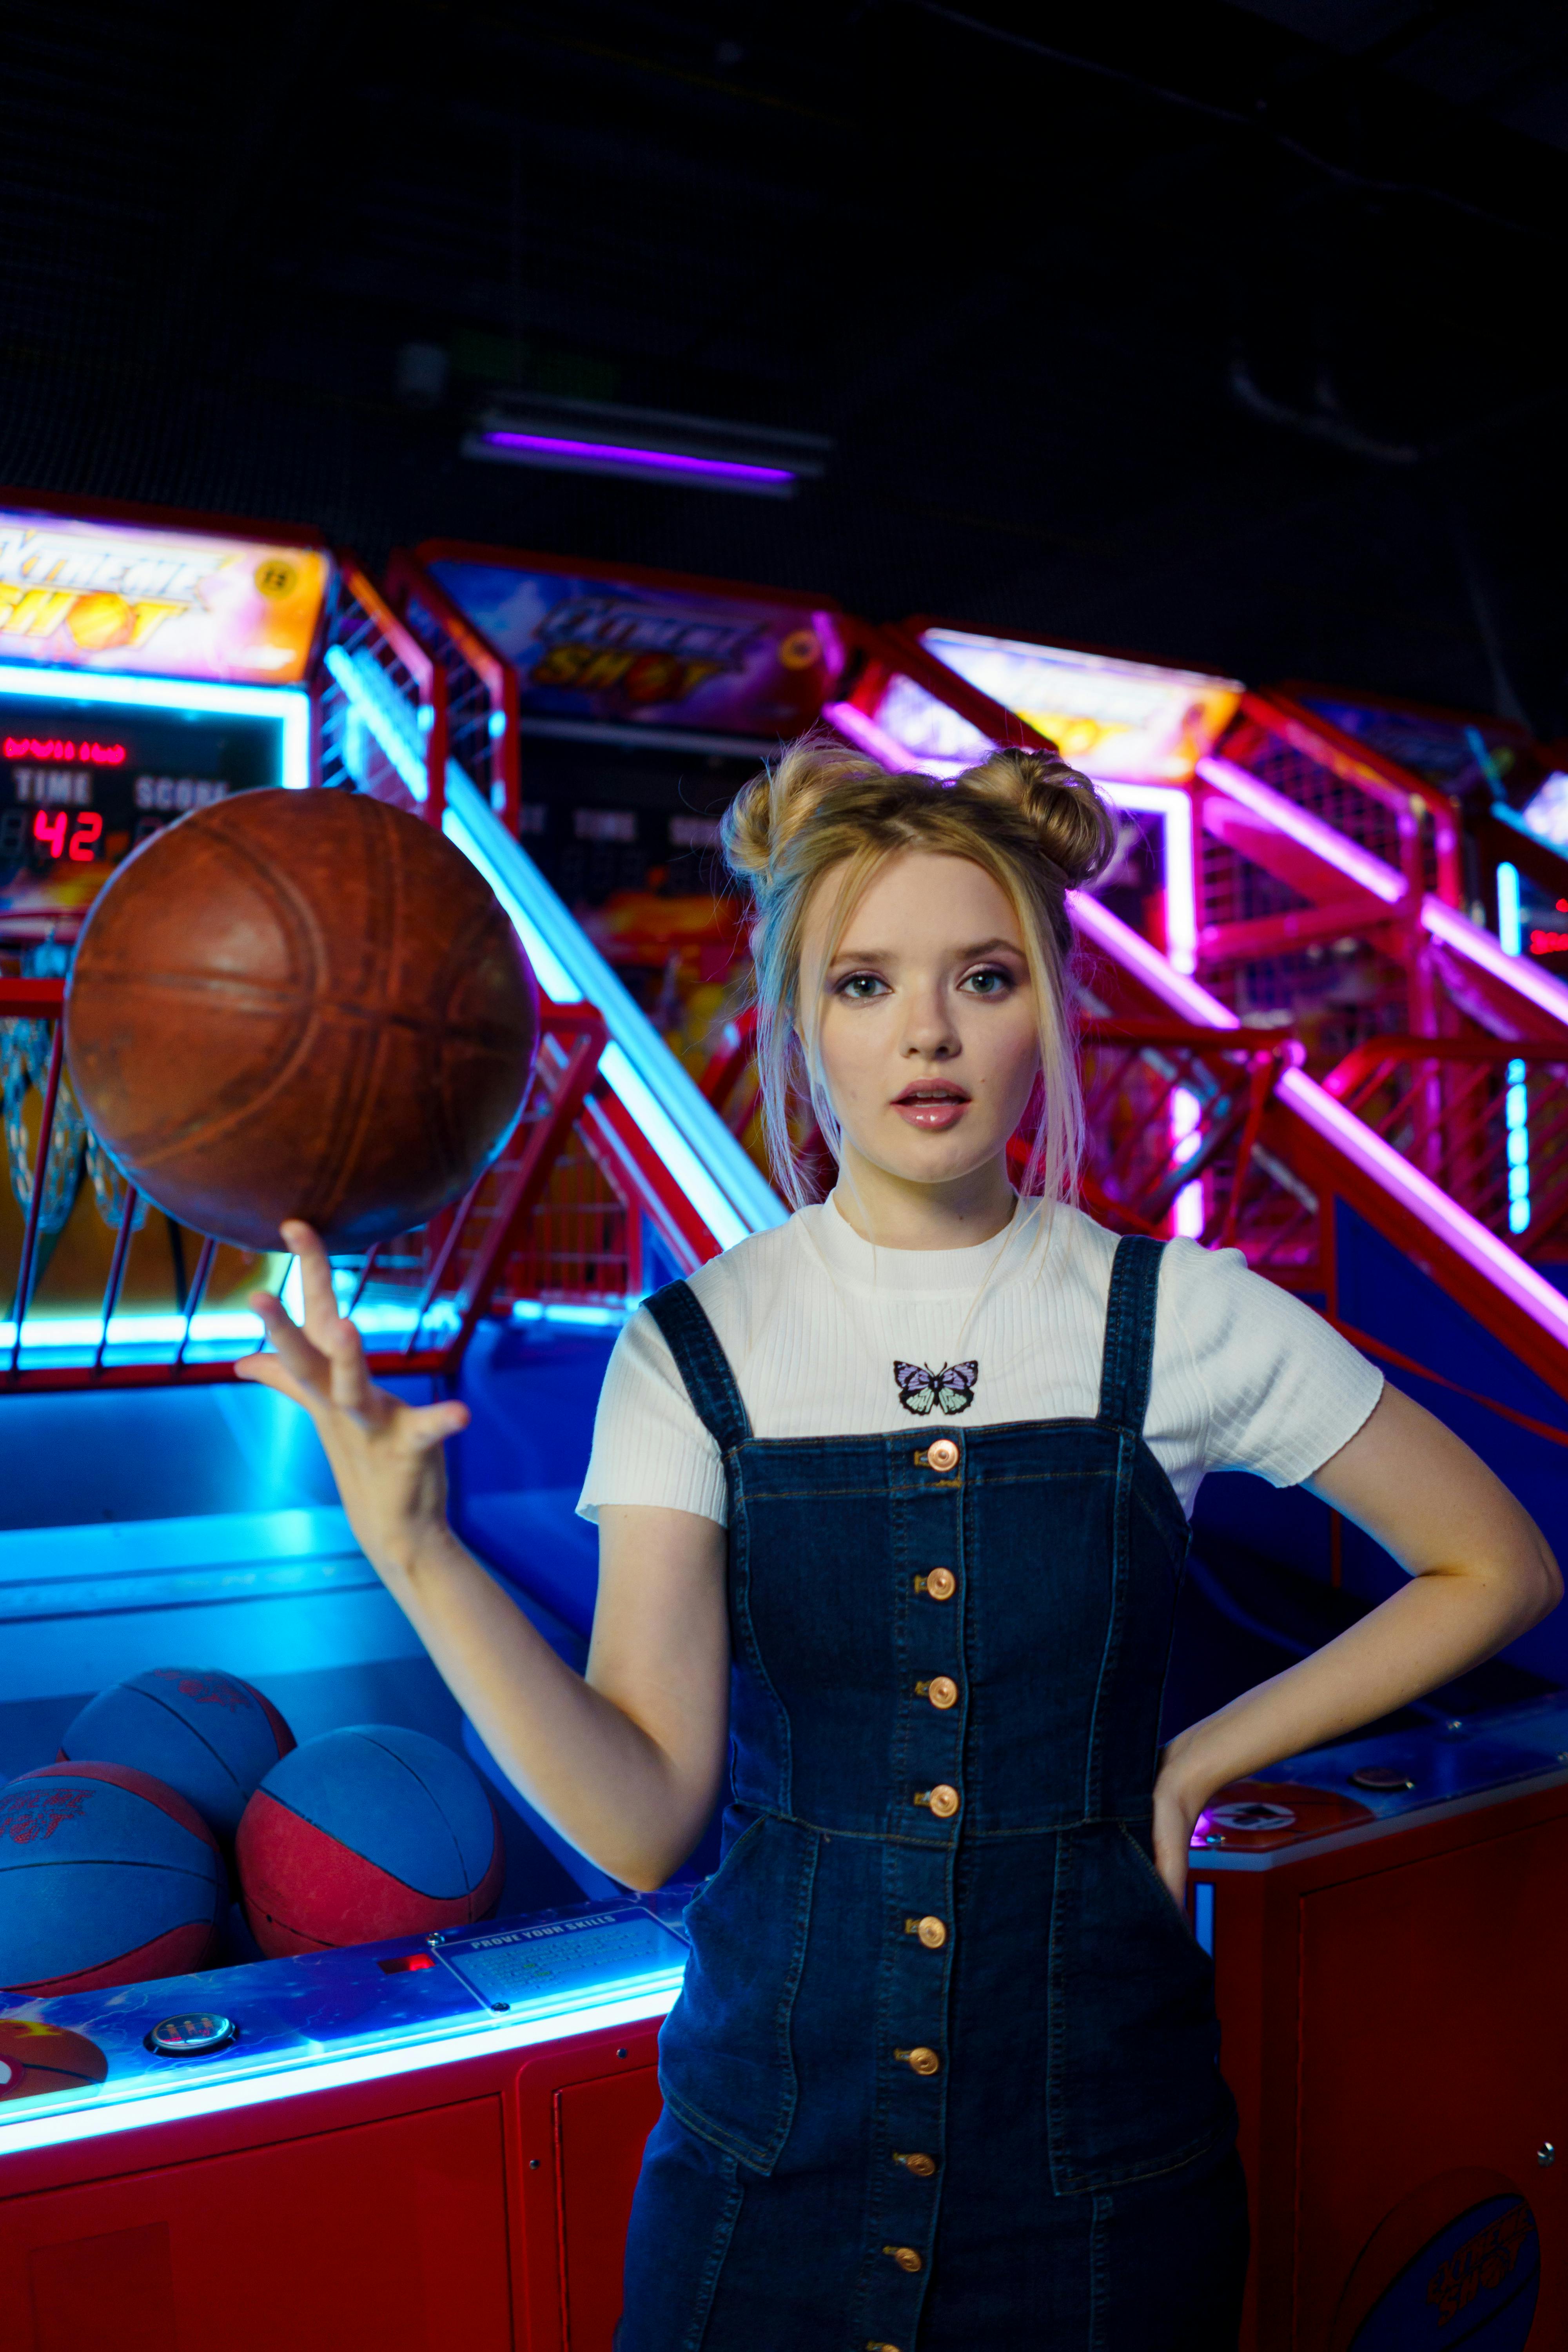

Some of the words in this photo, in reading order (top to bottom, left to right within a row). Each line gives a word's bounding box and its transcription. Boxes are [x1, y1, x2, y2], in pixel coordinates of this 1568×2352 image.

[14, 768, 91, 805] TIME
[34, 810, 103, 861] 42
[471, 1934, 522, 1950] PROVE
[522, 1925, 565, 1939] YOUR
[565, 1915, 616, 1931] SKILLS
